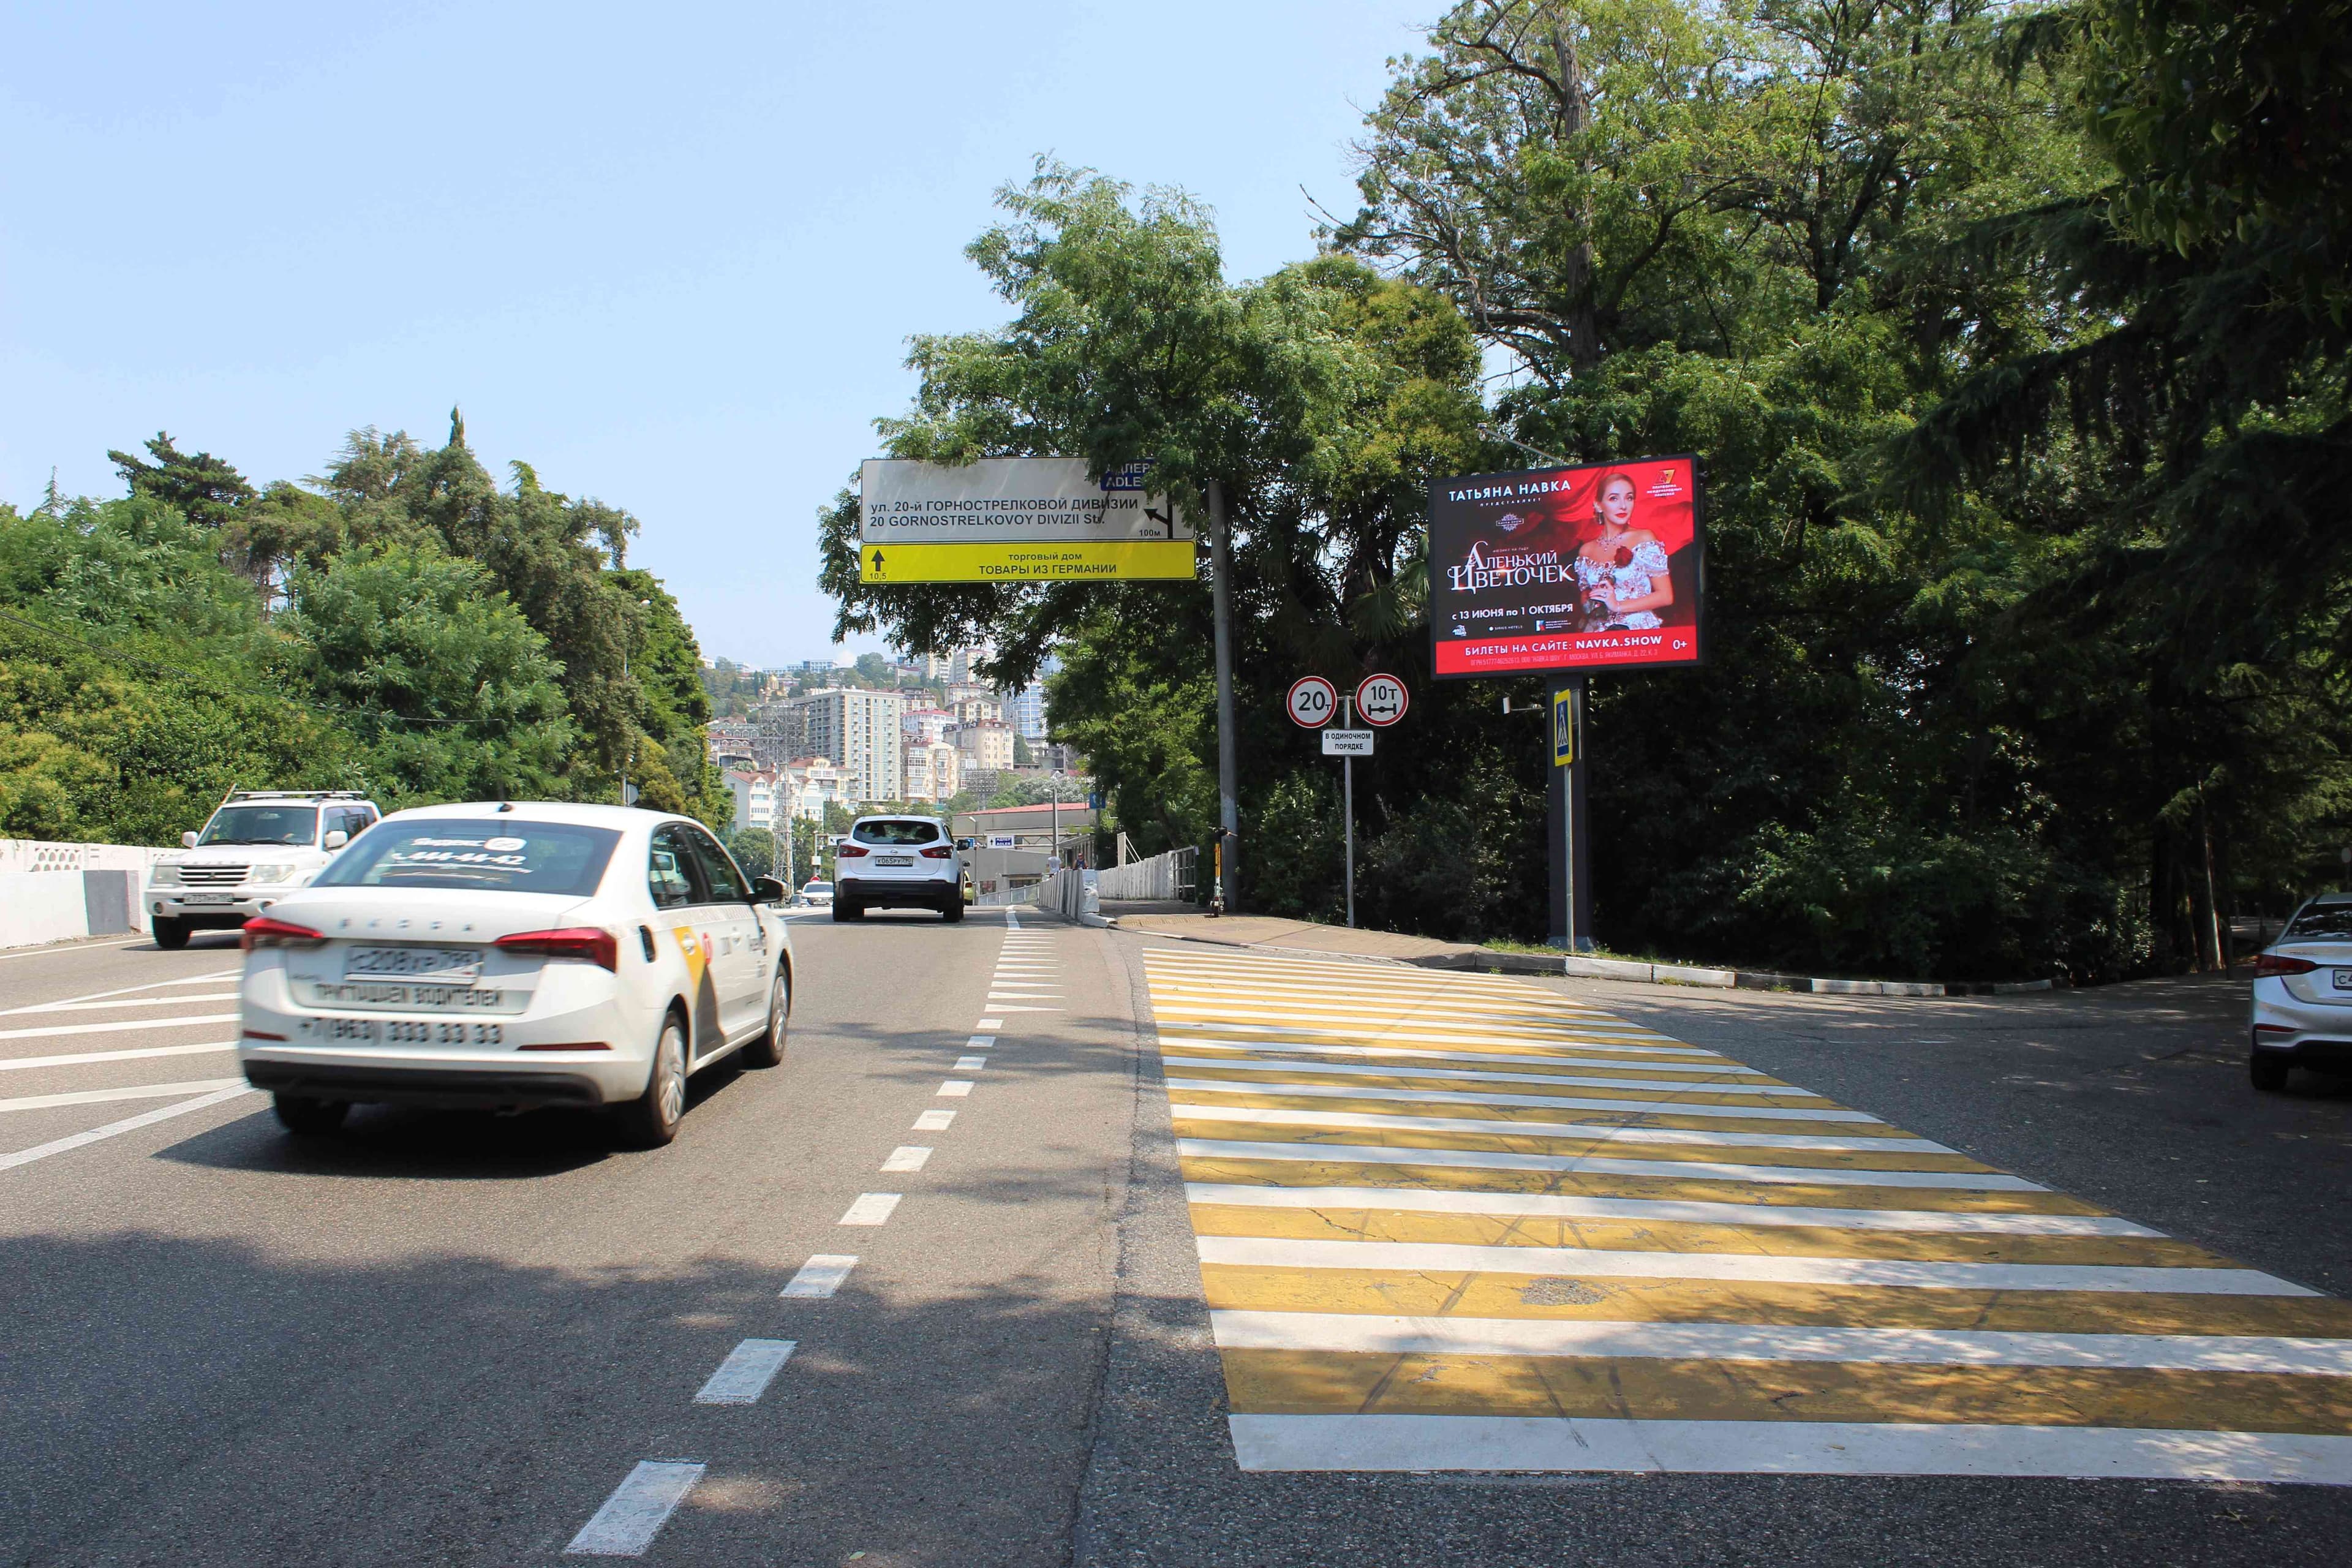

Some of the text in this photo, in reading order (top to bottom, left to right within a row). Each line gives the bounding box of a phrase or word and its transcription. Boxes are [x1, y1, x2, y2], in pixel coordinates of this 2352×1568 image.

[1106, 463, 1150, 475] ЛЕР
[1106, 477, 1142, 488] ADLE
[1449, 480, 1571, 502] ТАТЬЯНА НАВКА
[871, 497, 1138, 514] ул. 20-й ГОРНОСТРЕЛКОВОЙ ДИВИЗИИ
[1480, 497, 1541, 507] ПРЕДСТАВЛЯЕТ
[870, 516, 884, 527] 20
[889, 514, 1033, 527] GORNOSTRELKOVOY
[1037, 514, 1080, 525] DIVIZII
[1009, 552, 1082, 562] торговый дом
[979, 564, 1117, 575] ТОВАРЫ ИЗ ГЕРМАНИИ
[1460, 611, 1469, 620] 13
[1472, 608, 1504, 619] ИЮНЯ
[1521, 606, 1525, 616] 1
[1529, 603, 1574, 616] ОКТЯБРЯ
[1465, 636, 1662, 656] БИЛЕТЫ НА САЙТЕ: NAVKA.SHOW
[1673, 639, 1687, 650] 0+
[388, 1020, 431, 1042] 333
[436, 1022, 466, 1044] 33
[474, 1023, 503, 1044] 33
